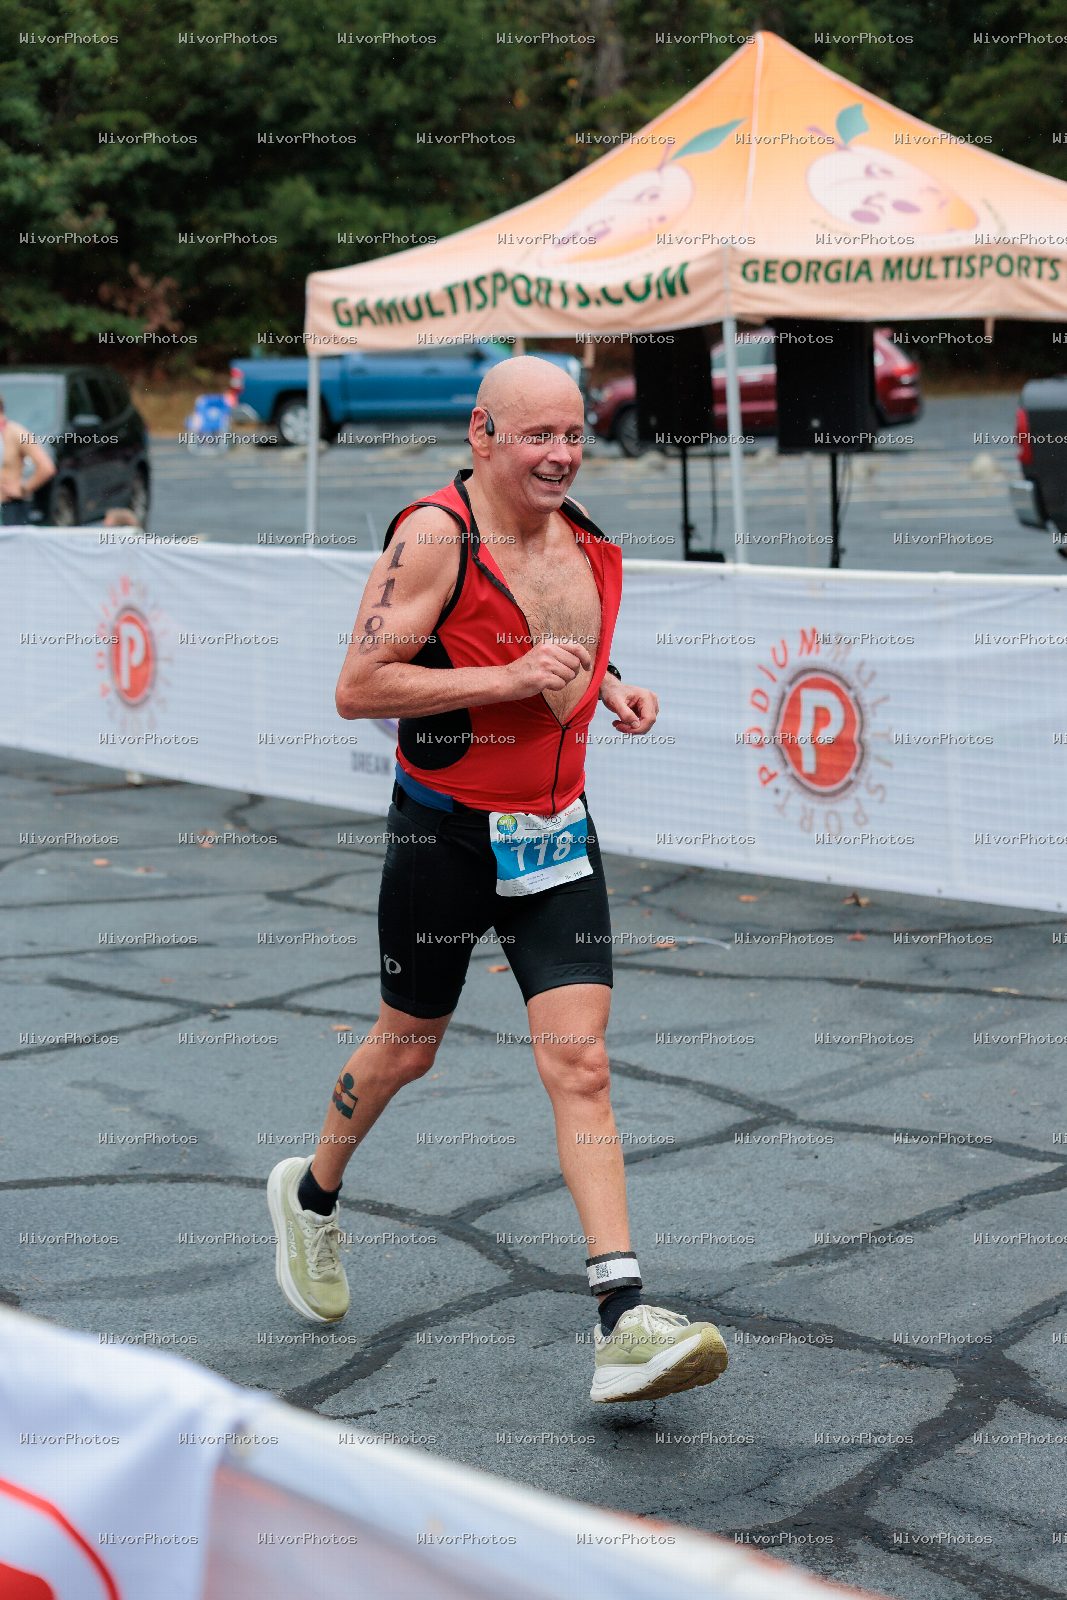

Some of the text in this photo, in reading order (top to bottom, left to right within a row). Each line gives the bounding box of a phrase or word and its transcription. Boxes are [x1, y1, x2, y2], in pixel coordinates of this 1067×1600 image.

[742, 252, 1061, 283] GEORGIA MULTISPORTS
[745, 627, 821, 788] PODIUM
[511, 831, 571, 872] 118
